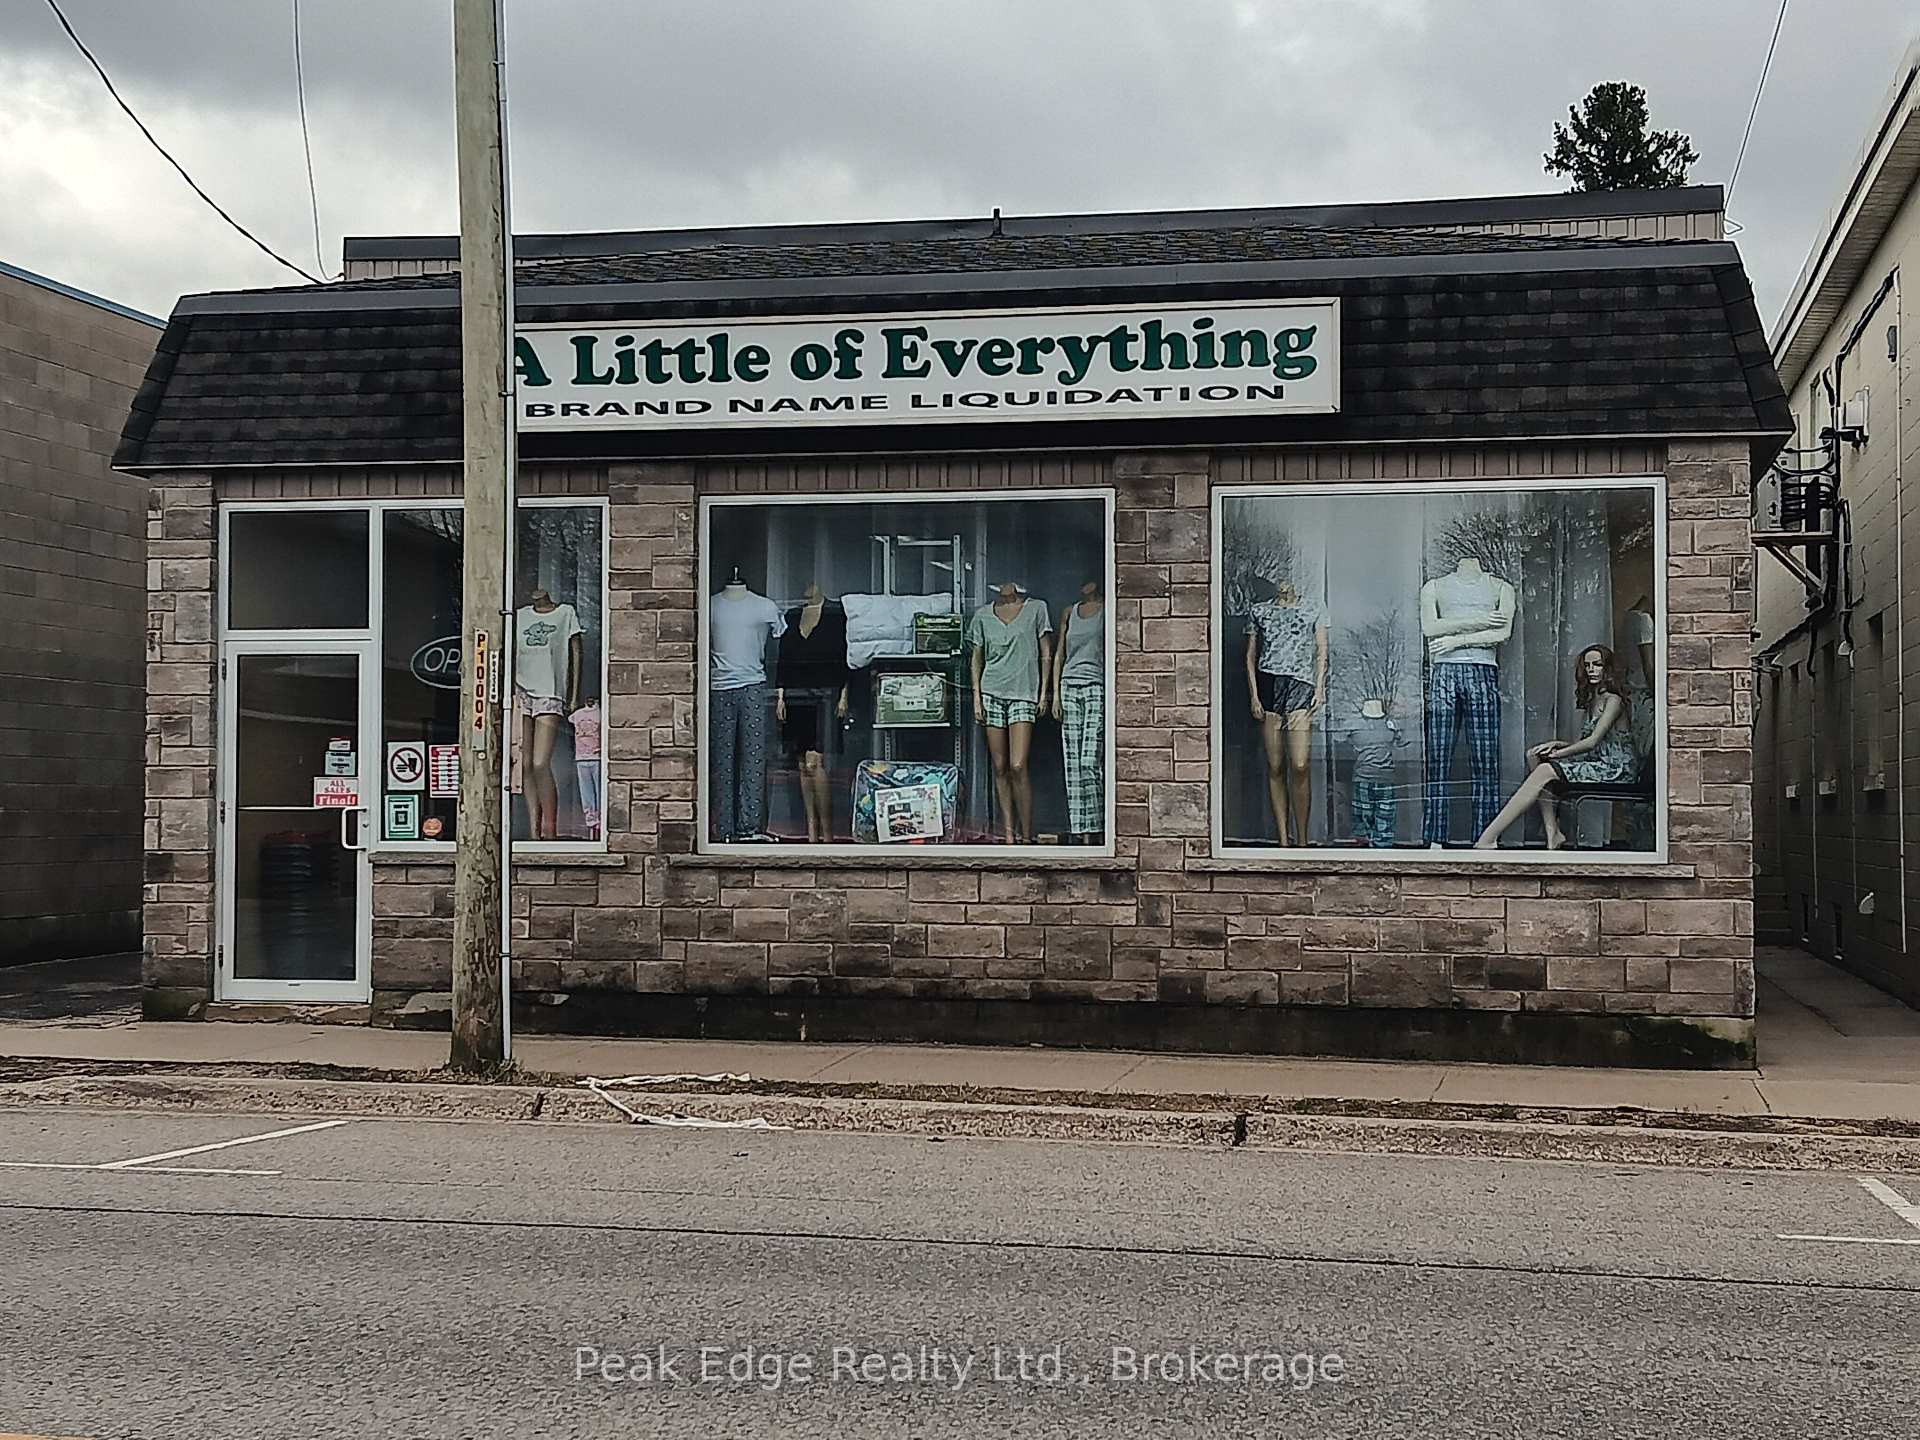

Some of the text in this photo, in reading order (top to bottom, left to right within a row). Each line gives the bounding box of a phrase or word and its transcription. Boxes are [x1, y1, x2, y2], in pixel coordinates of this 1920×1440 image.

[569, 333, 771, 385] Little
[790, 328, 865, 380] of
[881, 317, 1317, 386] Everything
[525, 385, 1284, 418] BRAND NAME LIQUIDATION
[424, 647, 461, 674] OP
